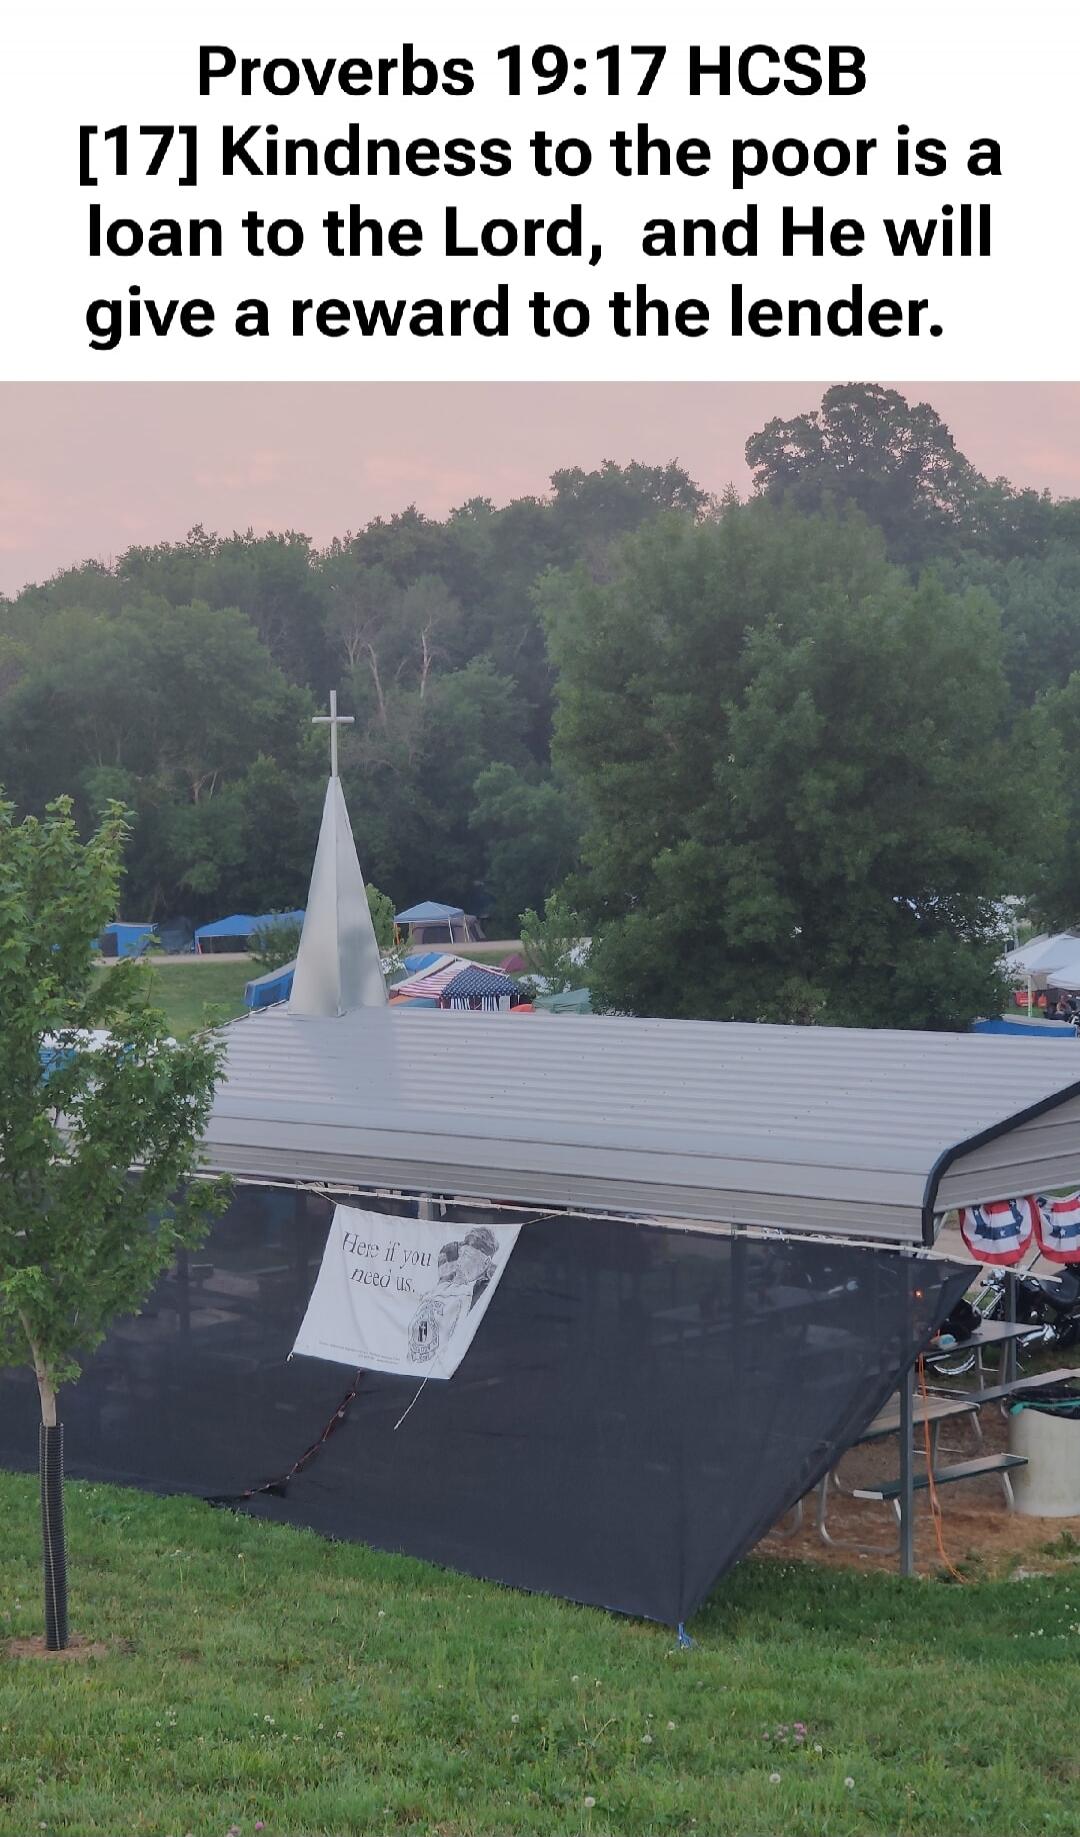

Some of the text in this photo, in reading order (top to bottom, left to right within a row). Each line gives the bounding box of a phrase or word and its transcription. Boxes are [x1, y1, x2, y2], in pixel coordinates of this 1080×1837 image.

[342, 1232, 432, 1269] Here if you
[350, 1268, 416, 1293] need us.
